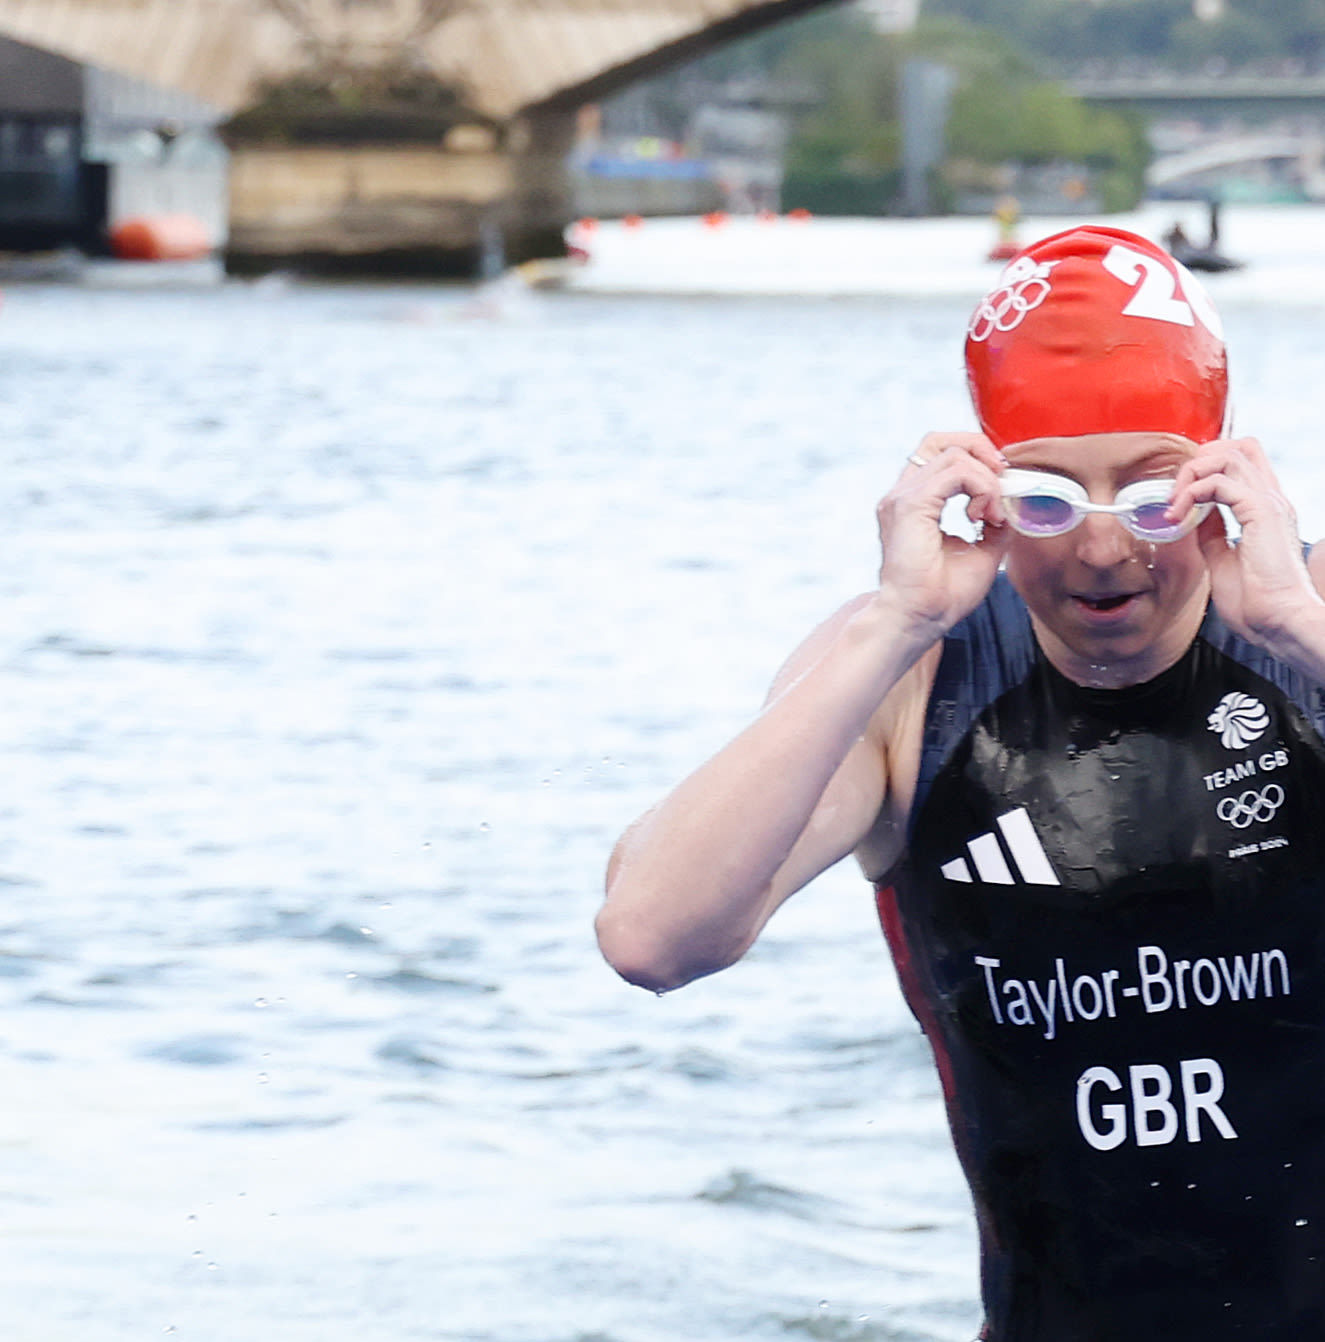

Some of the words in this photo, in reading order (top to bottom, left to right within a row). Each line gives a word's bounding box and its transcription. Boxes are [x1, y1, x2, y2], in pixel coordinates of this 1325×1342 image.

[1203, 760, 1256, 791] TEAM
[1258, 750, 1289, 771] GB
[974, 946, 1290, 1040] Taylor-Brown
[1076, 1058, 1239, 1151] GBR
